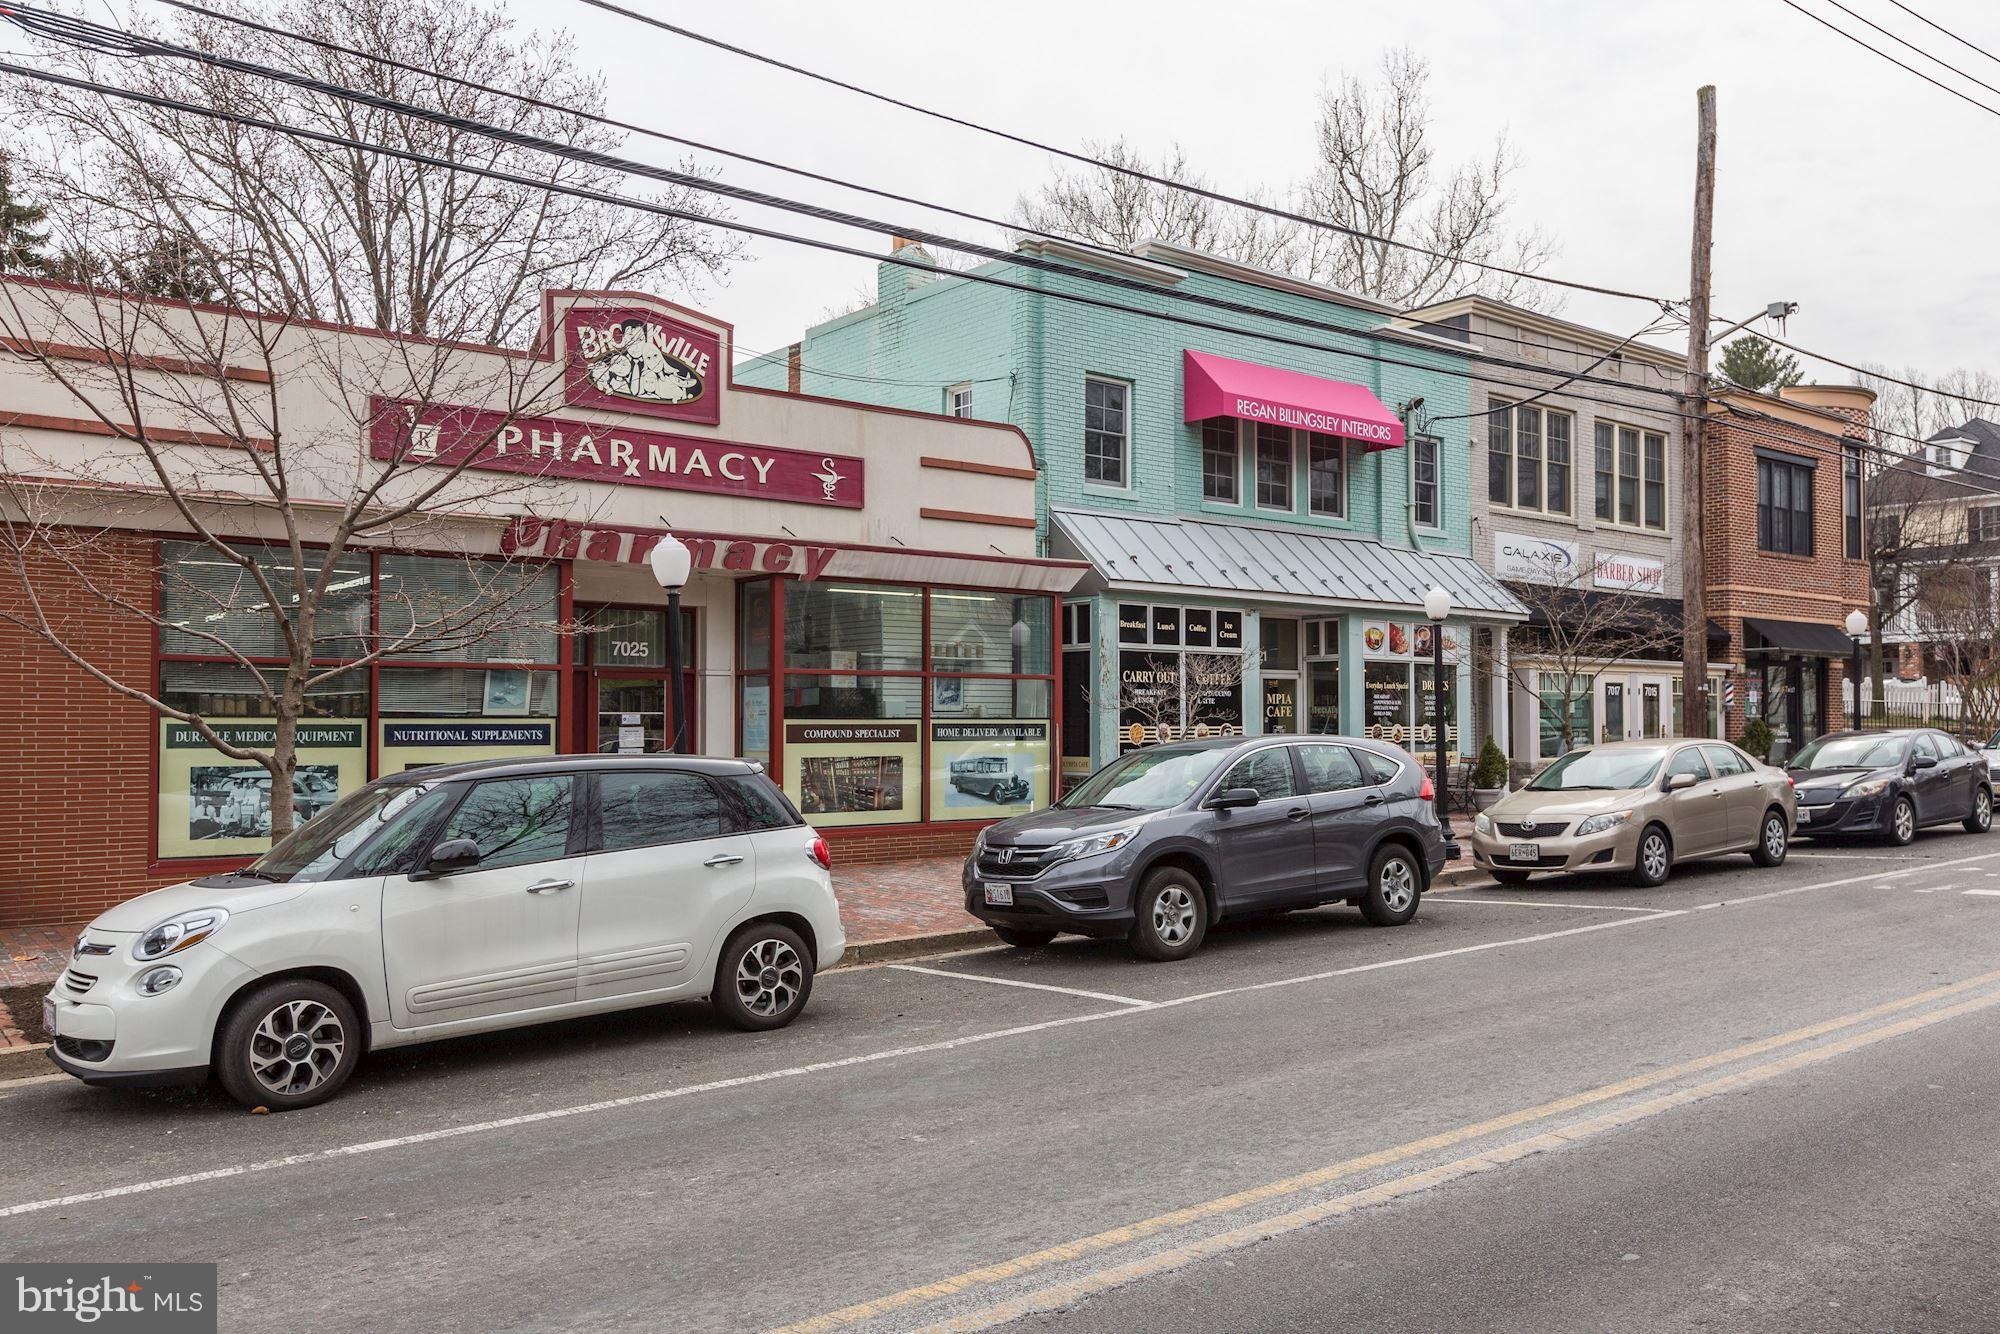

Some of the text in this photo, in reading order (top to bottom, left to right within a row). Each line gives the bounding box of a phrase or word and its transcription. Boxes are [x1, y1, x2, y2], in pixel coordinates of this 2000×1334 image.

[1237, 399, 1392, 441] REGAN BILLINGSLEY INTERIORS
[1597, 560, 1664, 586] BARBER SHOP
[1120, 620, 1146, 629] Breakfast
[1157, 622, 1175, 631] Lunch
[1189, 624, 1207, 633] Coffee
[1224, 621, 1233, 630] Ice
[1219, 631, 1238, 639] Cream
[611, 641, 649, 657] 7025
[1123, 670, 1176, 684] CARRY OUT
[1422, 680, 1449, 691] DRIS
[1607, 686, 1620, 696] 7017
[1266, 693, 1292, 704] MPIA
[1266, 705, 1293, 717] CAFE
[235, 730, 277, 743] MEDICA
[394, 730, 543, 742] NUTRITIONAL SUPPLEMENTS
[804, 729, 901, 739] COMPOUND SPECIALIST
[937, 727, 1042, 737] HOME DELIVERY AVAILABLE
